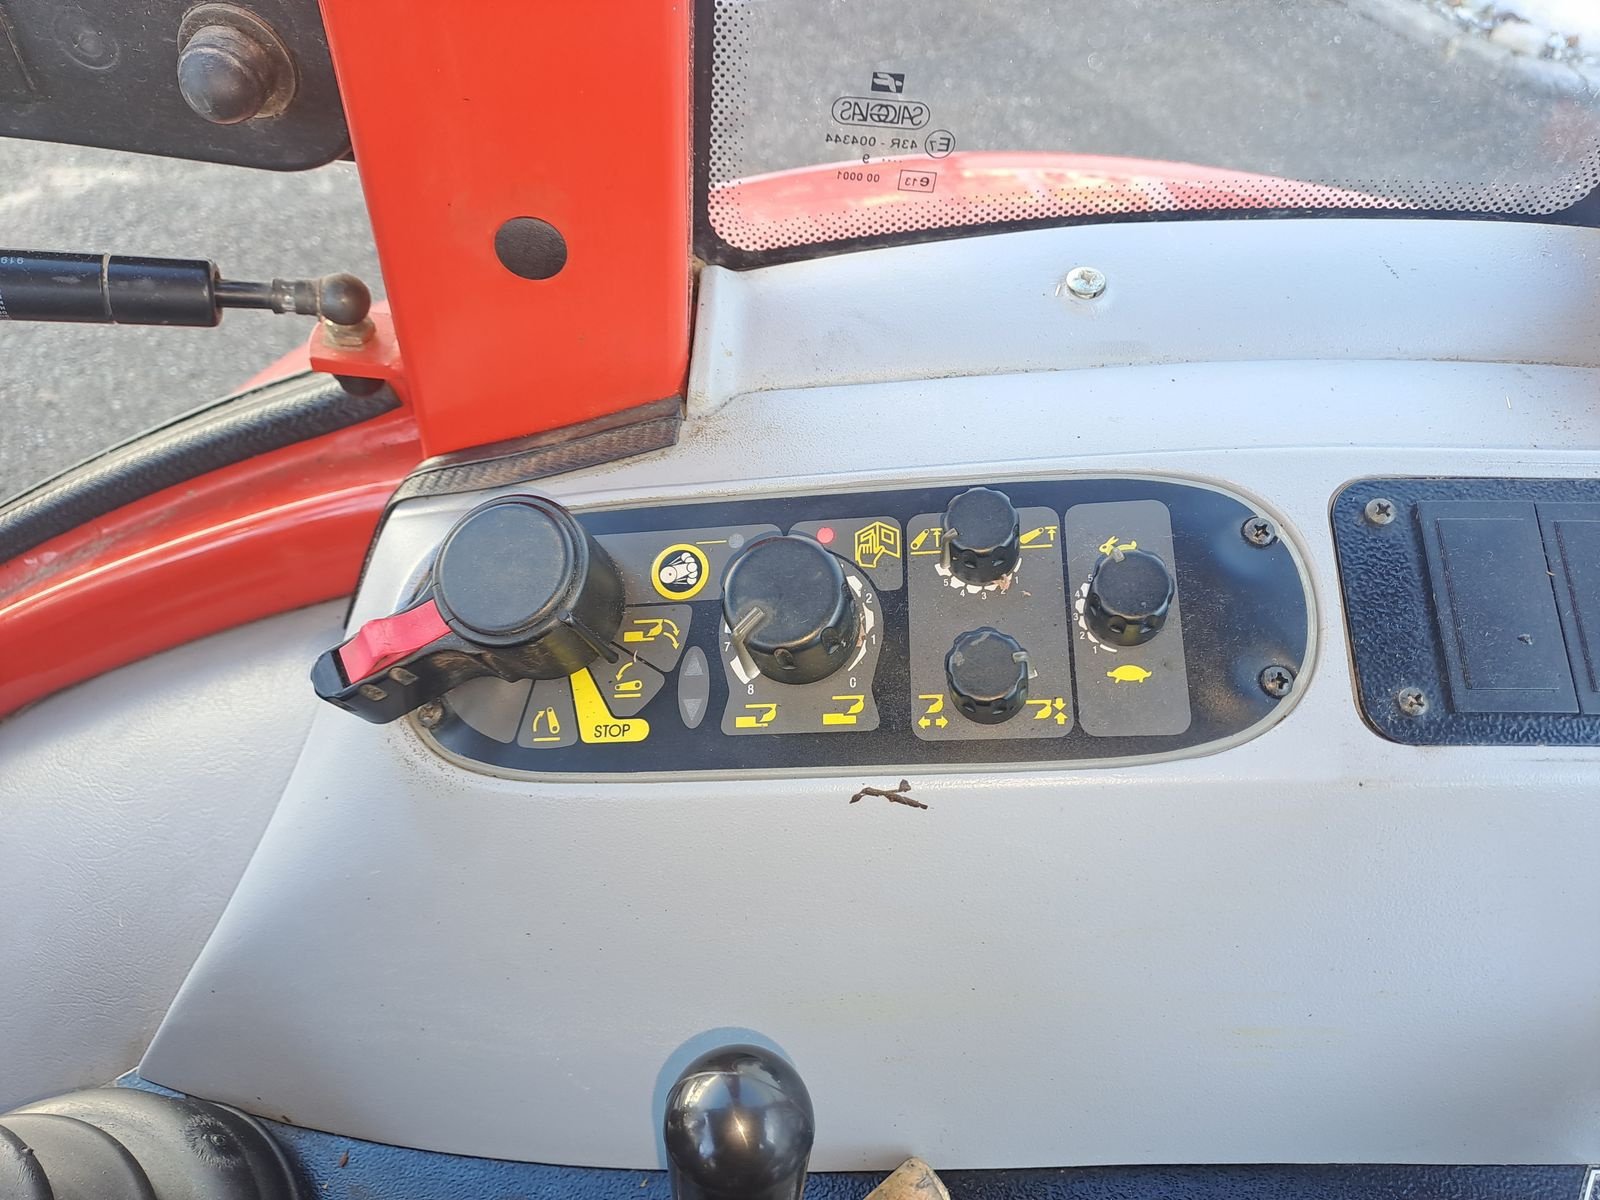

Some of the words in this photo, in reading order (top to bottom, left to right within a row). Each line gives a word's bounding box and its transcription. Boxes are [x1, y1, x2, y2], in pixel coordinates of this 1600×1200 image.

[866, 593, 873, 604] 2
[724, 641, 731, 653] 7
[747, 684, 755, 695] 8
[594, 724, 630, 738] STOP
